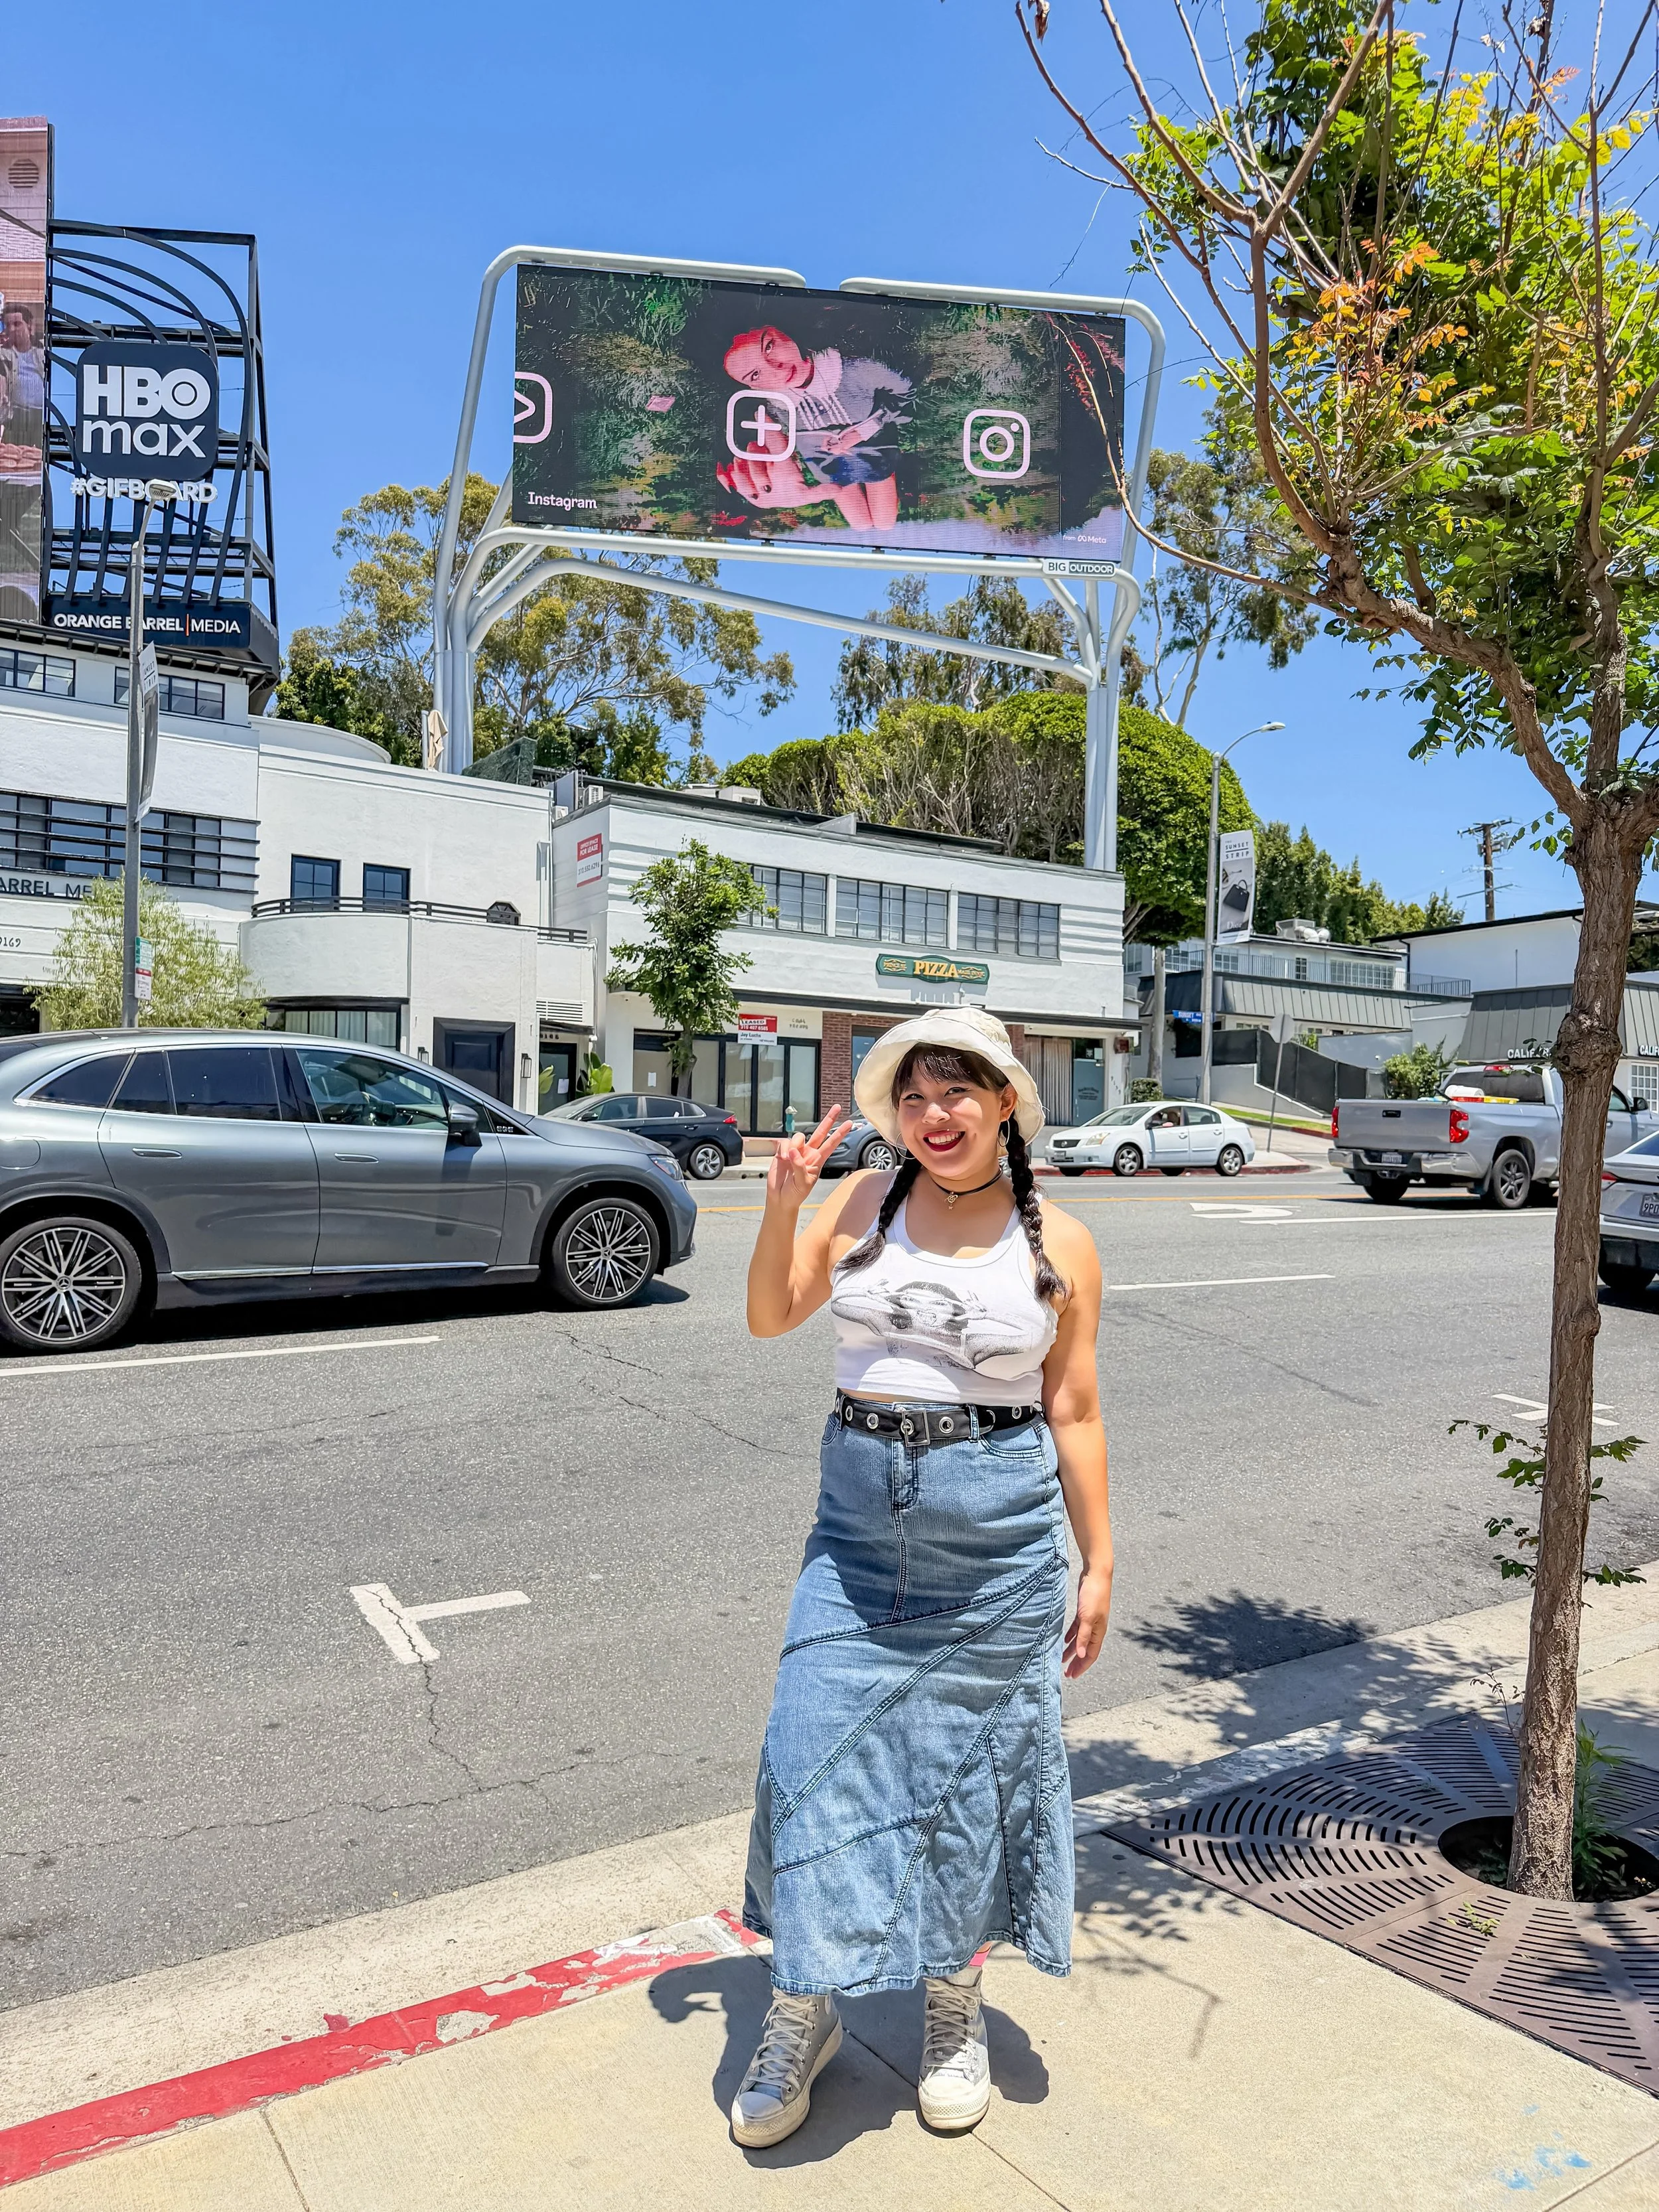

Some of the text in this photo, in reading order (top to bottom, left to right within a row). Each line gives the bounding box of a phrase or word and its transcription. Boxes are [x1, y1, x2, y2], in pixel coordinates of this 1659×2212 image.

[83, 364, 211, 420] HBO
[82, 420, 206, 458] max
[528, 491, 597, 511] Instagram
[1048, 562, 1114, 573] BIG OUTDOOR
[54, 613, 122, 629] ORANGE
[191, 619, 241, 634] MEDIA
[1225, 841, 1249, 850] SUNSET
[1225, 850, 1250, 859] STRIP
[914, 960, 959, 978] PIZZA
[1639, 1045, 1659, 1057] CALIF
